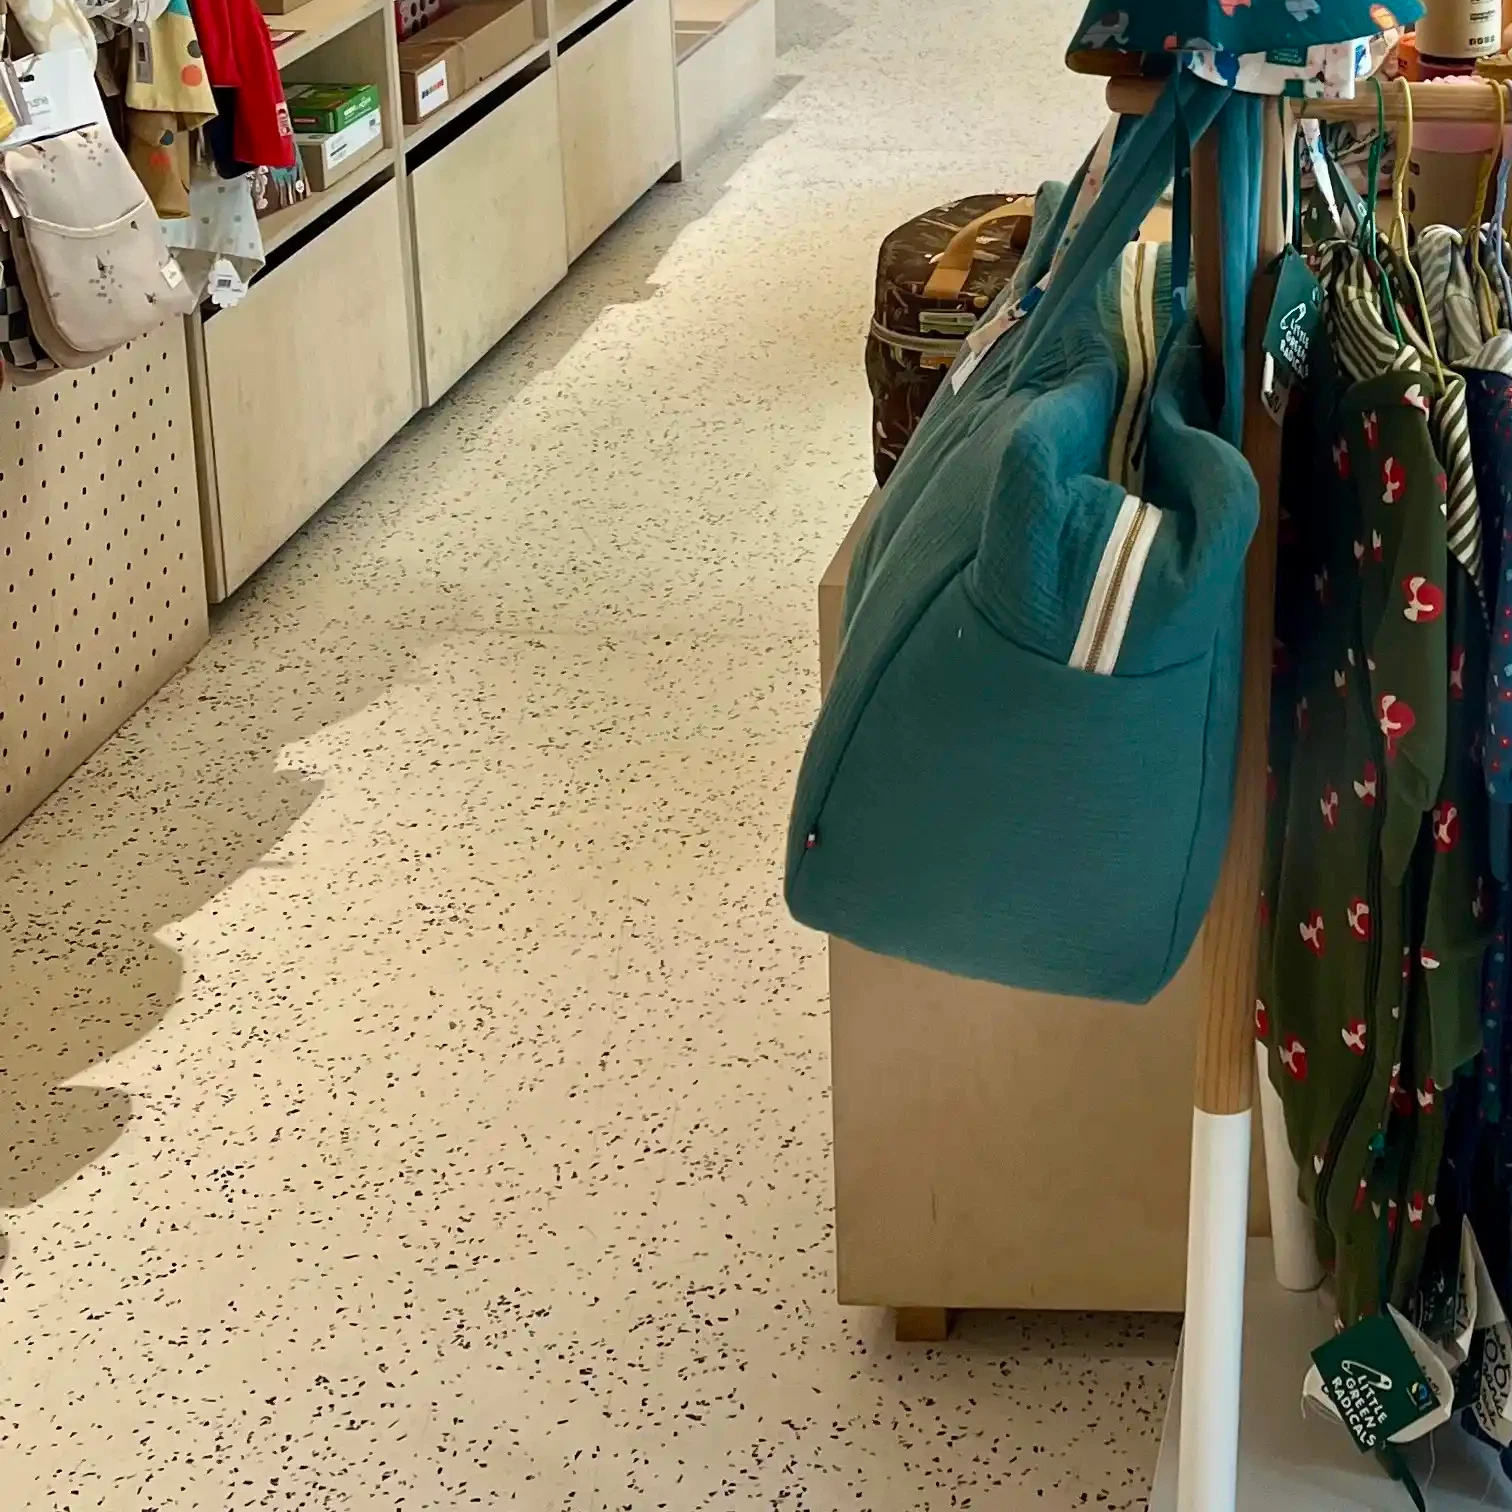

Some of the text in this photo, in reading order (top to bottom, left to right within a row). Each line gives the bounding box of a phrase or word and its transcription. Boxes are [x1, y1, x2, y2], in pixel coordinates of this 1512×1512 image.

[1285, 330, 1306, 363] GREEN
[1291, 318, 1310, 349] LITTLE
[1331, 1376, 1377, 1446] RADICALS
[1345, 1377, 1376, 1428] GREEN
[1358, 1374, 1388, 1424] LITTLE
